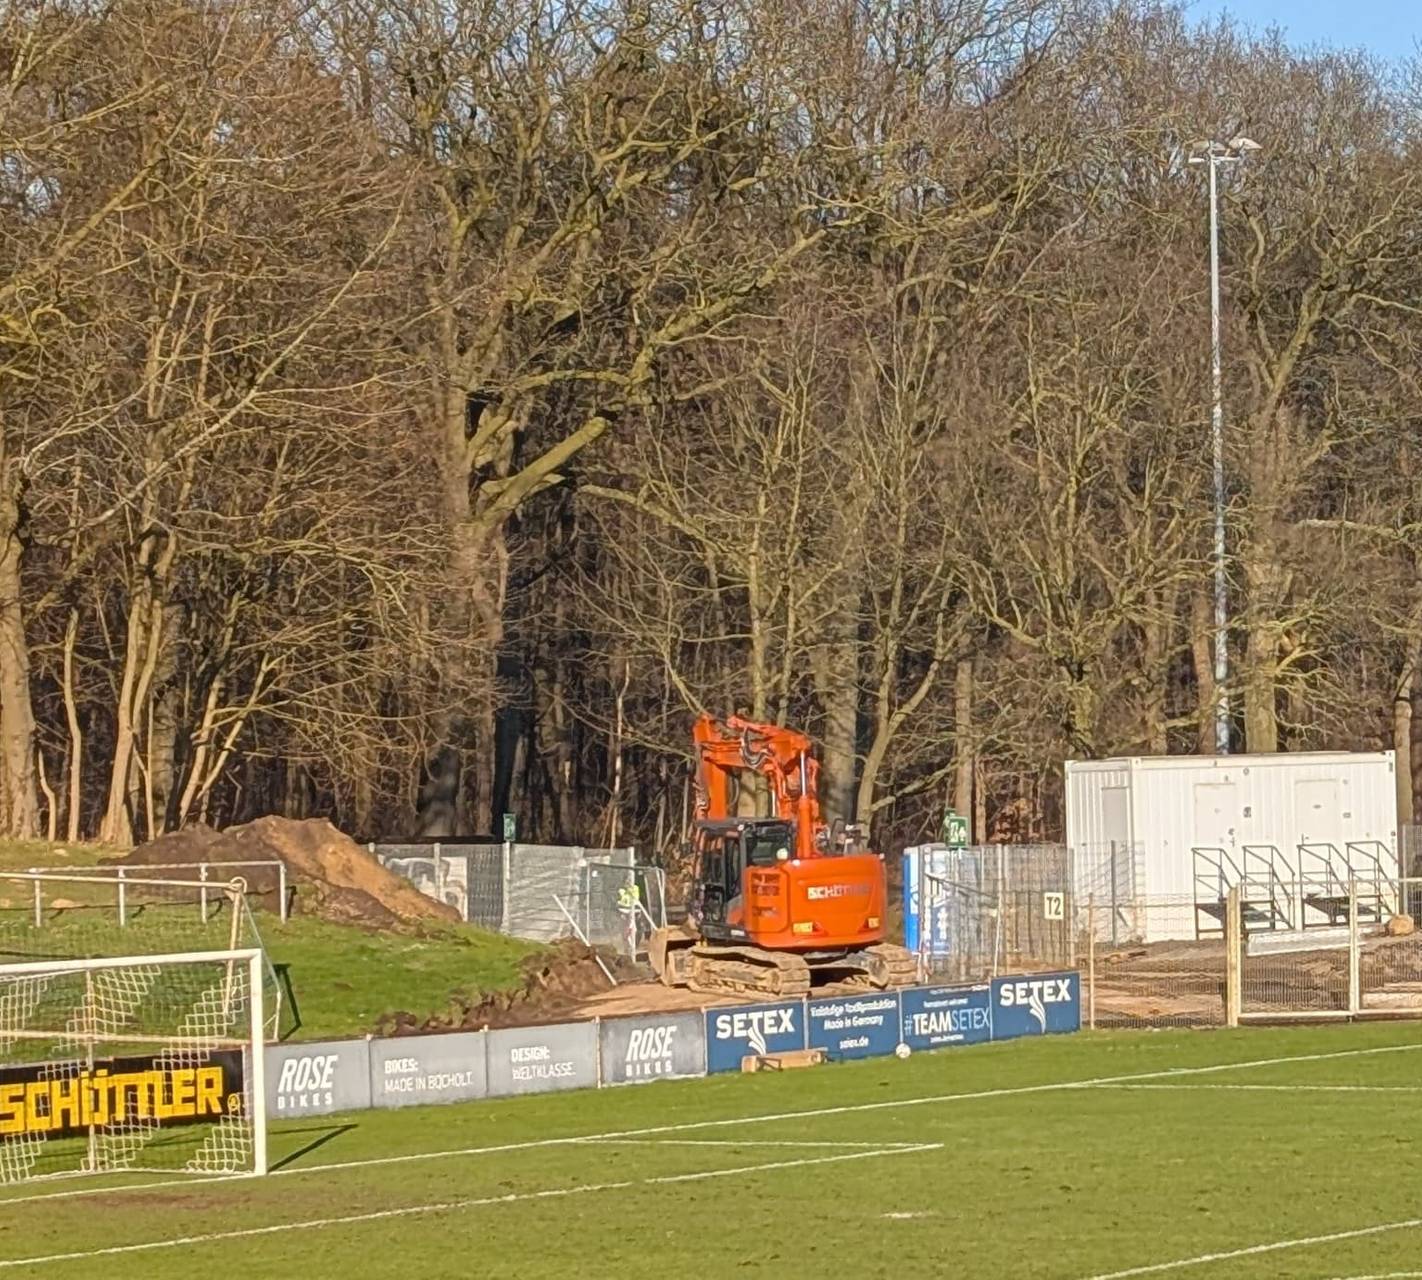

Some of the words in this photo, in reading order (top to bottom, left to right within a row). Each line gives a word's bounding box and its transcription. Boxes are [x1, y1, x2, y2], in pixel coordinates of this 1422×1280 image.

[1046, 896, 1061, 916] T2
[1000, 978, 1072, 1007] SETEX
[716, 1008, 795, 1039] SETEX
[824, 1018, 843, 1030] Made
[853, 1014, 884, 1027] Germany
[904, 1006, 990, 1037] #TEAMSETEX
[626, 1026, 677, 1062] ROSE
[278, 1055, 338, 1093] ROSE
[384, 1058, 418, 1074] BIKES:
[625, 1060, 673, 1077] BIKES
[384, 1077, 413, 1094] MADE
[415, 1076, 426, 1090] IN
[0, 1066, 223, 1133] SCHÖTTLER
[278, 1092, 333, 1110] BIKES
